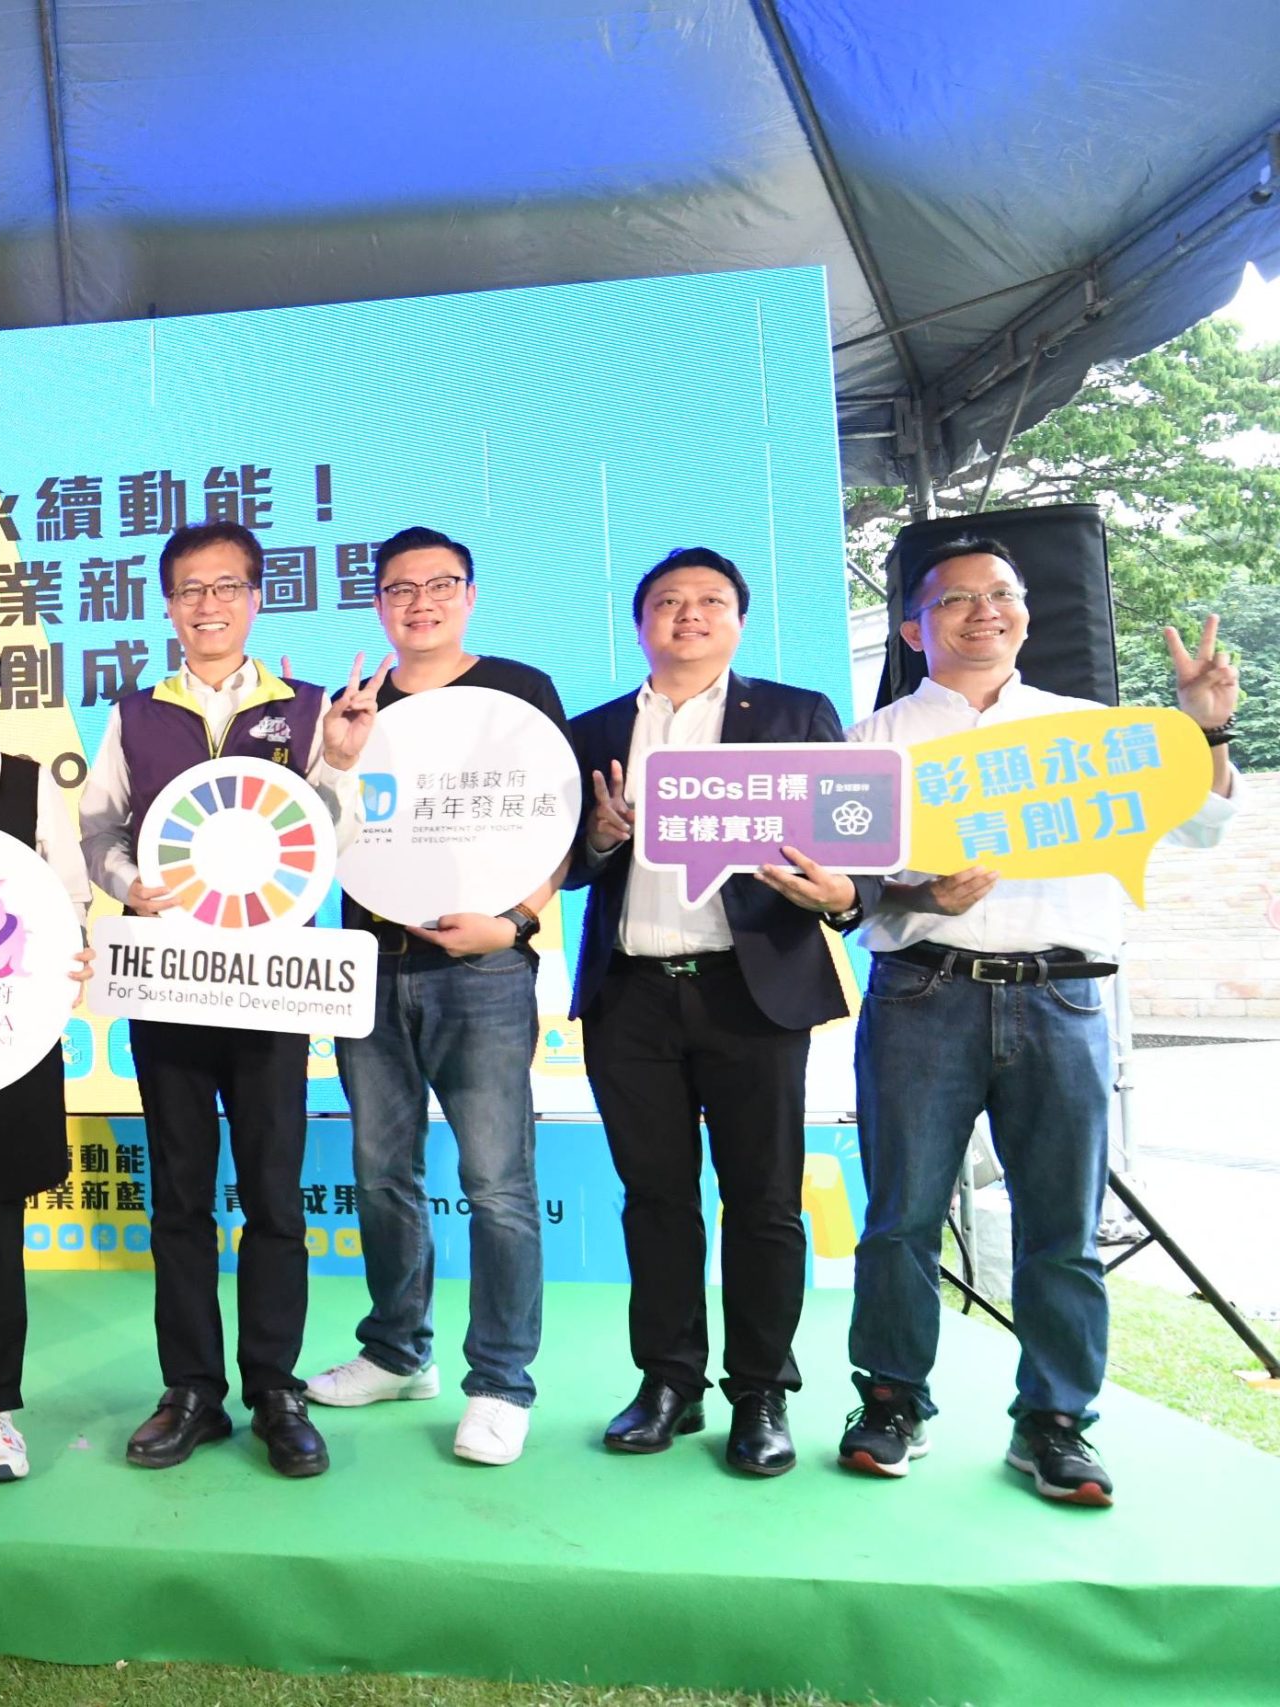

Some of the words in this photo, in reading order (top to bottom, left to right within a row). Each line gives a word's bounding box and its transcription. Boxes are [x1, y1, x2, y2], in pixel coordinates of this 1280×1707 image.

[914, 723, 1162, 806] 彰顯永續
[417, 769, 528, 790] 彰化縣政府
[657, 773, 809, 801] SDGs目標
[820, 779, 834, 795] 17
[413, 793, 558, 820] 青年發展處
[412, 824, 471, 833] DEPARTMENT
[474, 824, 487, 832] OF
[490, 824, 524, 832] YOUTH
[657, 815, 785, 843] 這樣實現
[954, 790, 1148, 860] 青創力
[411, 835, 477, 844] DEVELOPMENT
[109, 943, 156, 978] THE
[160, 948, 260, 986] GLOBAL
[266, 955, 356, 993] GOALS
[108, 981, 134, 999] For
[137, 984, 235, 1008] Sustainable
[238, 992, 353, 1017] Development
